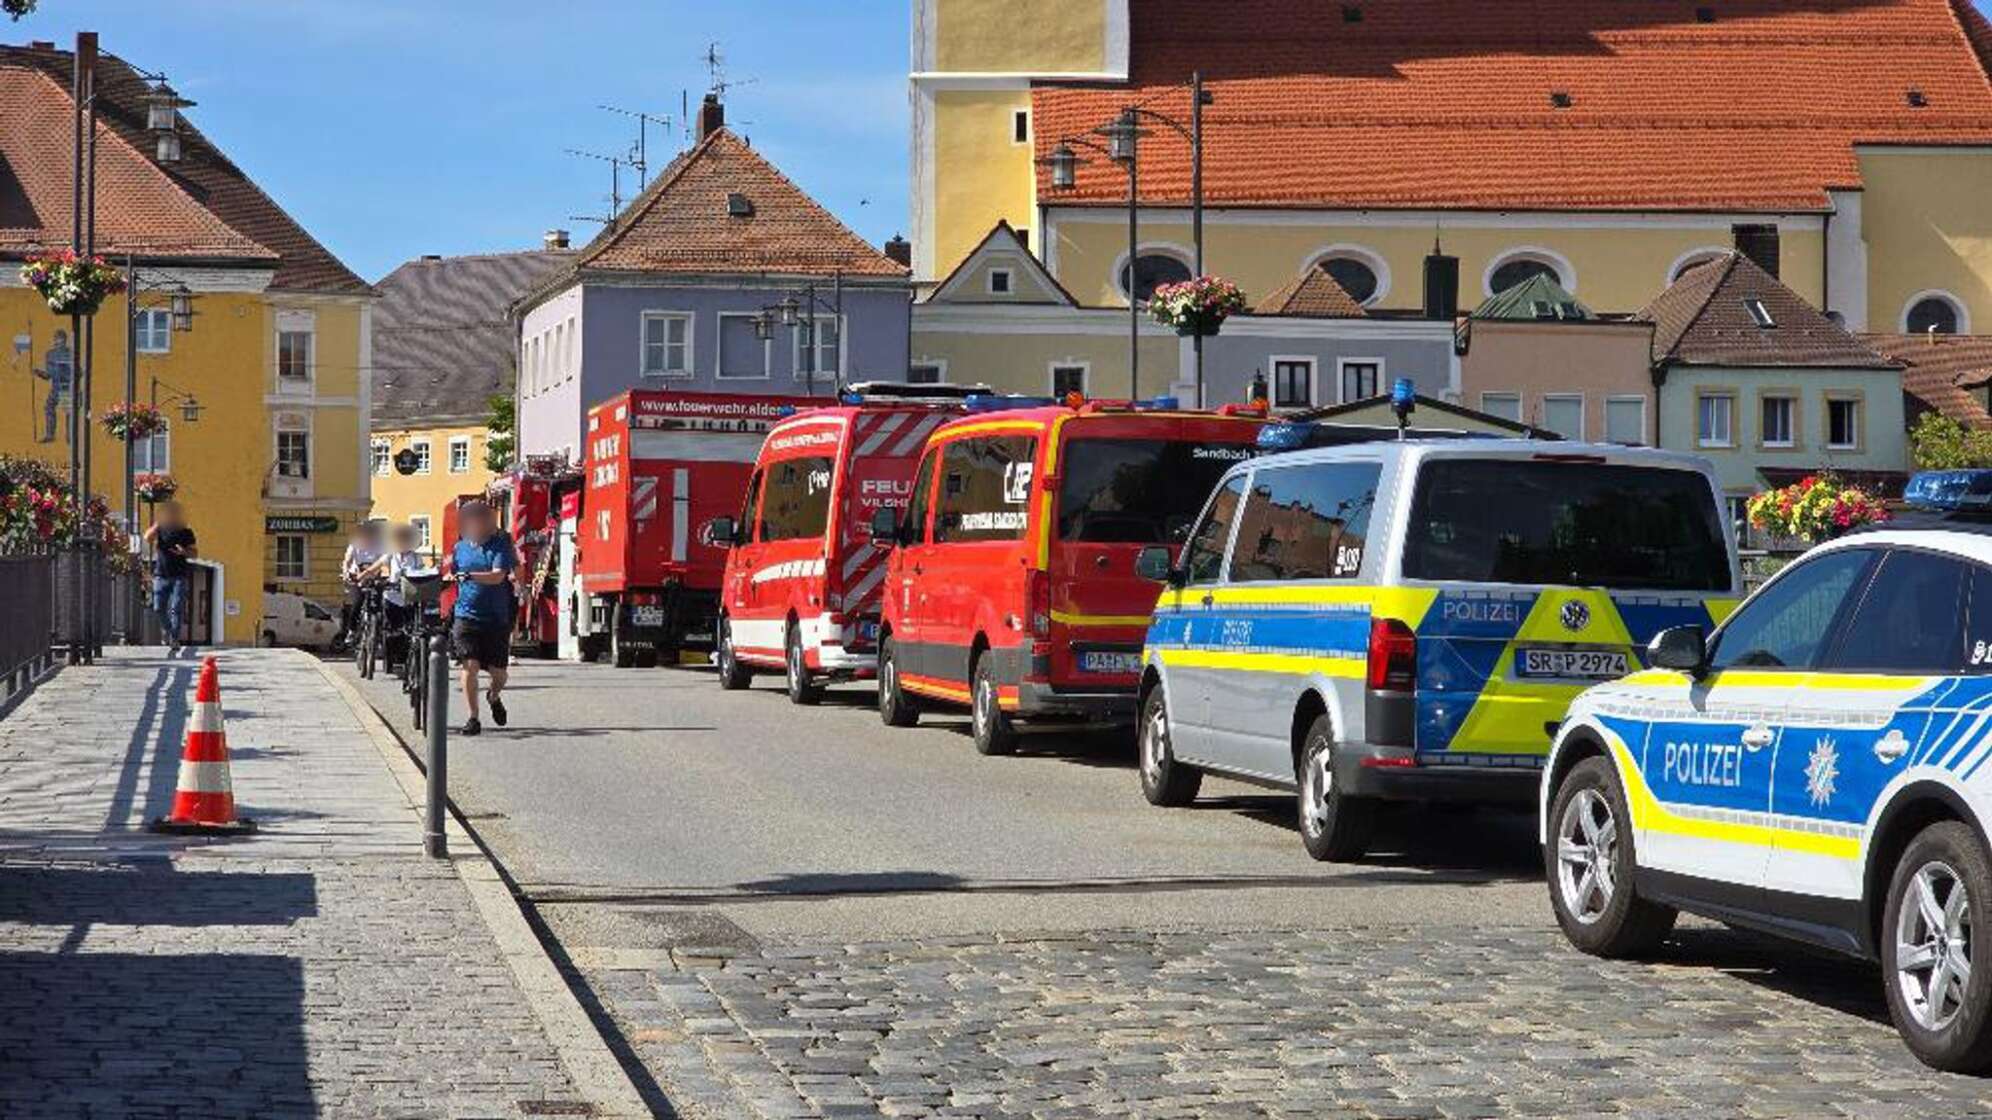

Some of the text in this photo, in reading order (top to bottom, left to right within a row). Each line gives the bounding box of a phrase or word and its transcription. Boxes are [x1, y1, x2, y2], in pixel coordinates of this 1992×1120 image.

[1192, 446, 1252, 460] Sandbach
[1443, 601, 1520, 621] POLIZEI
[1528, 652, 1626, 673] SR P 2974
[1663, 742, 1742, 788] POLIZEI
